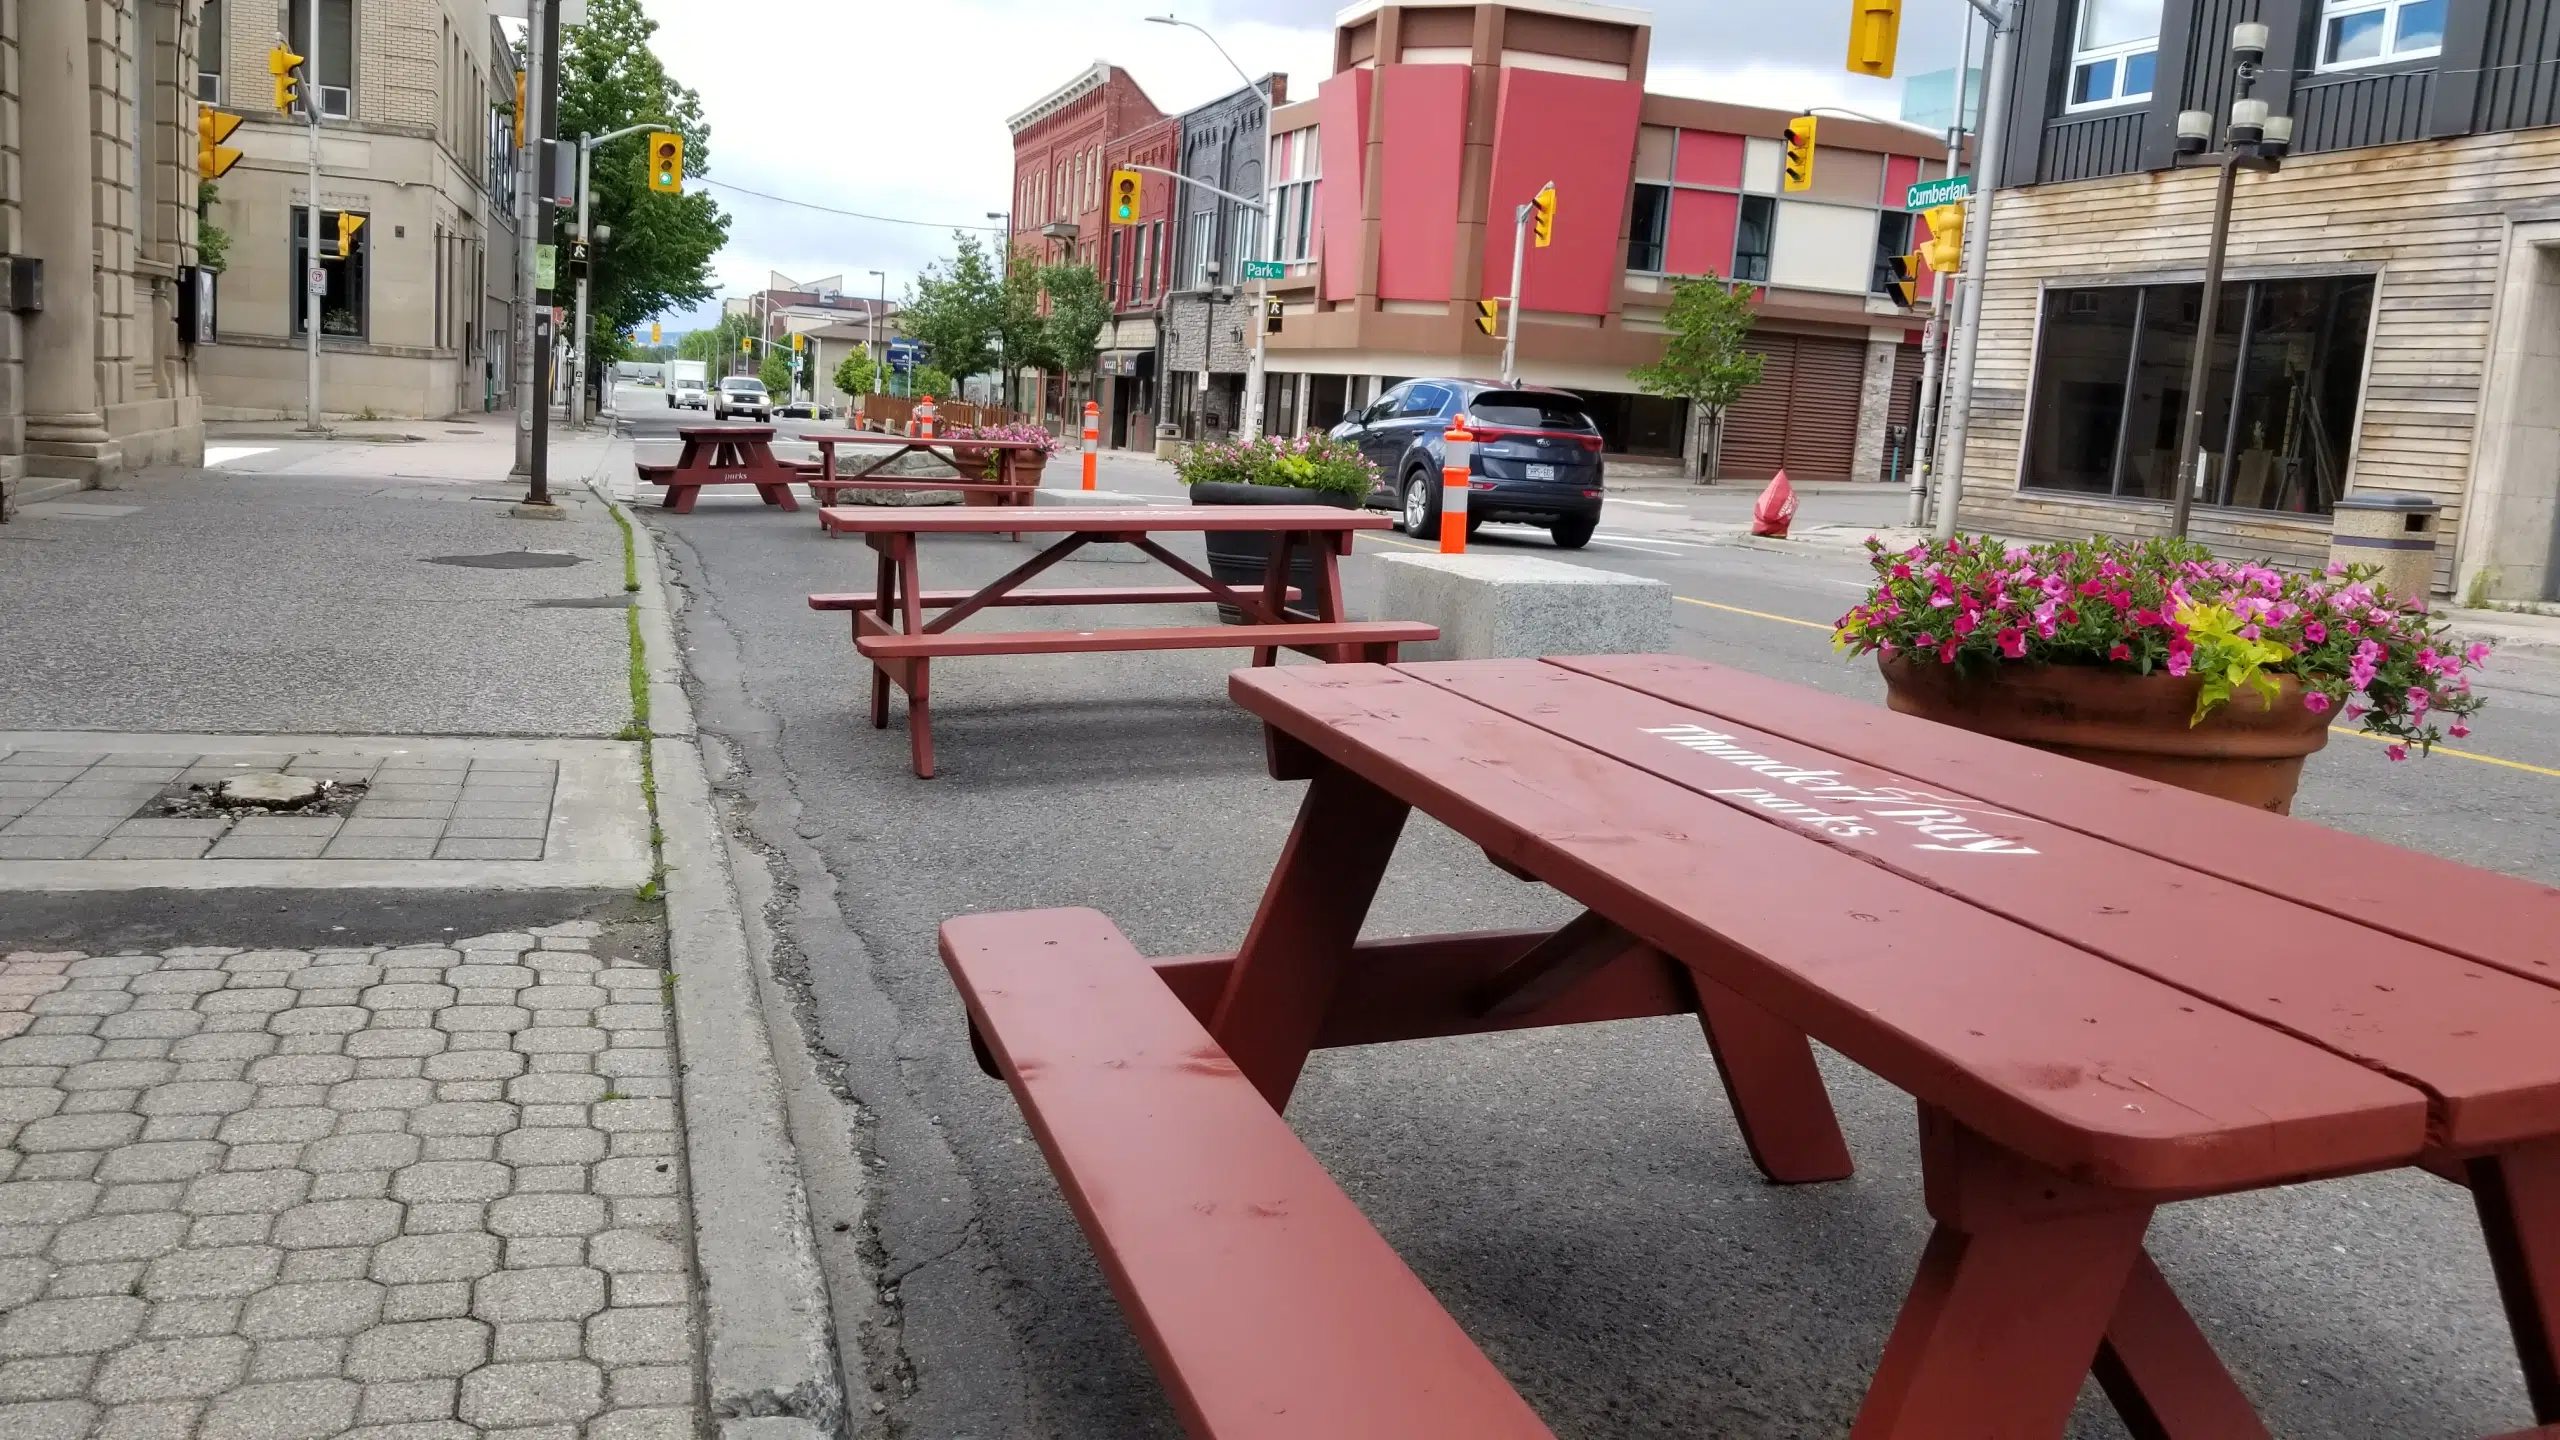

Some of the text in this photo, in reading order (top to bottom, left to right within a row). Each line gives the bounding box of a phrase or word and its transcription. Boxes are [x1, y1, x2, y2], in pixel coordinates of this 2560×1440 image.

[1247, 262, 1274, 277] Park
[724, 472, 748, 482] parks
[1636, 723, 2042, 855] Thunder Bay
[1706, 786, 1879, 838] parks
